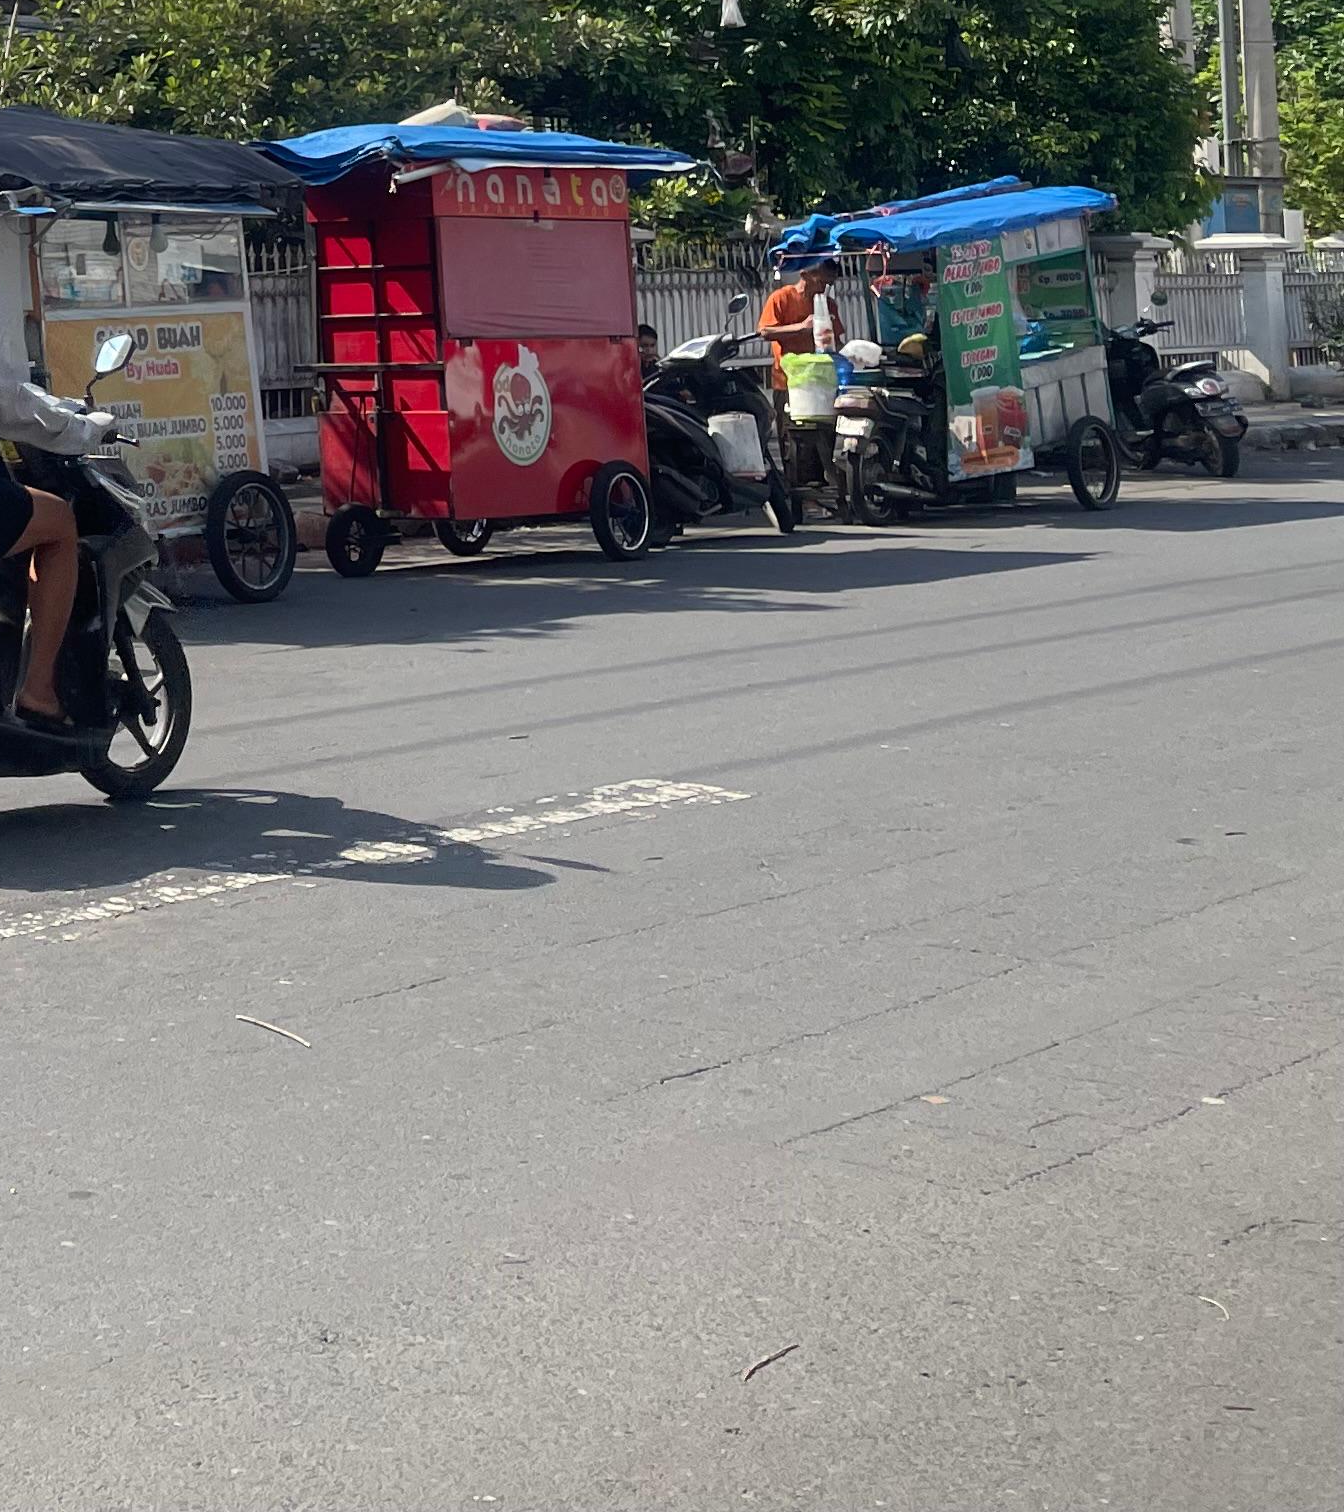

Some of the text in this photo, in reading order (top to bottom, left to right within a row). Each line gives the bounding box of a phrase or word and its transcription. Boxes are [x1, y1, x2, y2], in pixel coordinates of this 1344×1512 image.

[157, 326, 202, 350] BUAH
[126, 359, 179, 381] By Huda
[211, 395, 246, 411] 10.000
[137, 420, 167, 438] BUAH
[170, 418, 207, 436] JUMBO
[213, 414, 244, 430] 5.000
[215, 434, 246, 450] 5.000
[217, 453, 248, 470] 5.000
[170, 496, 207, 516] JUMBO
